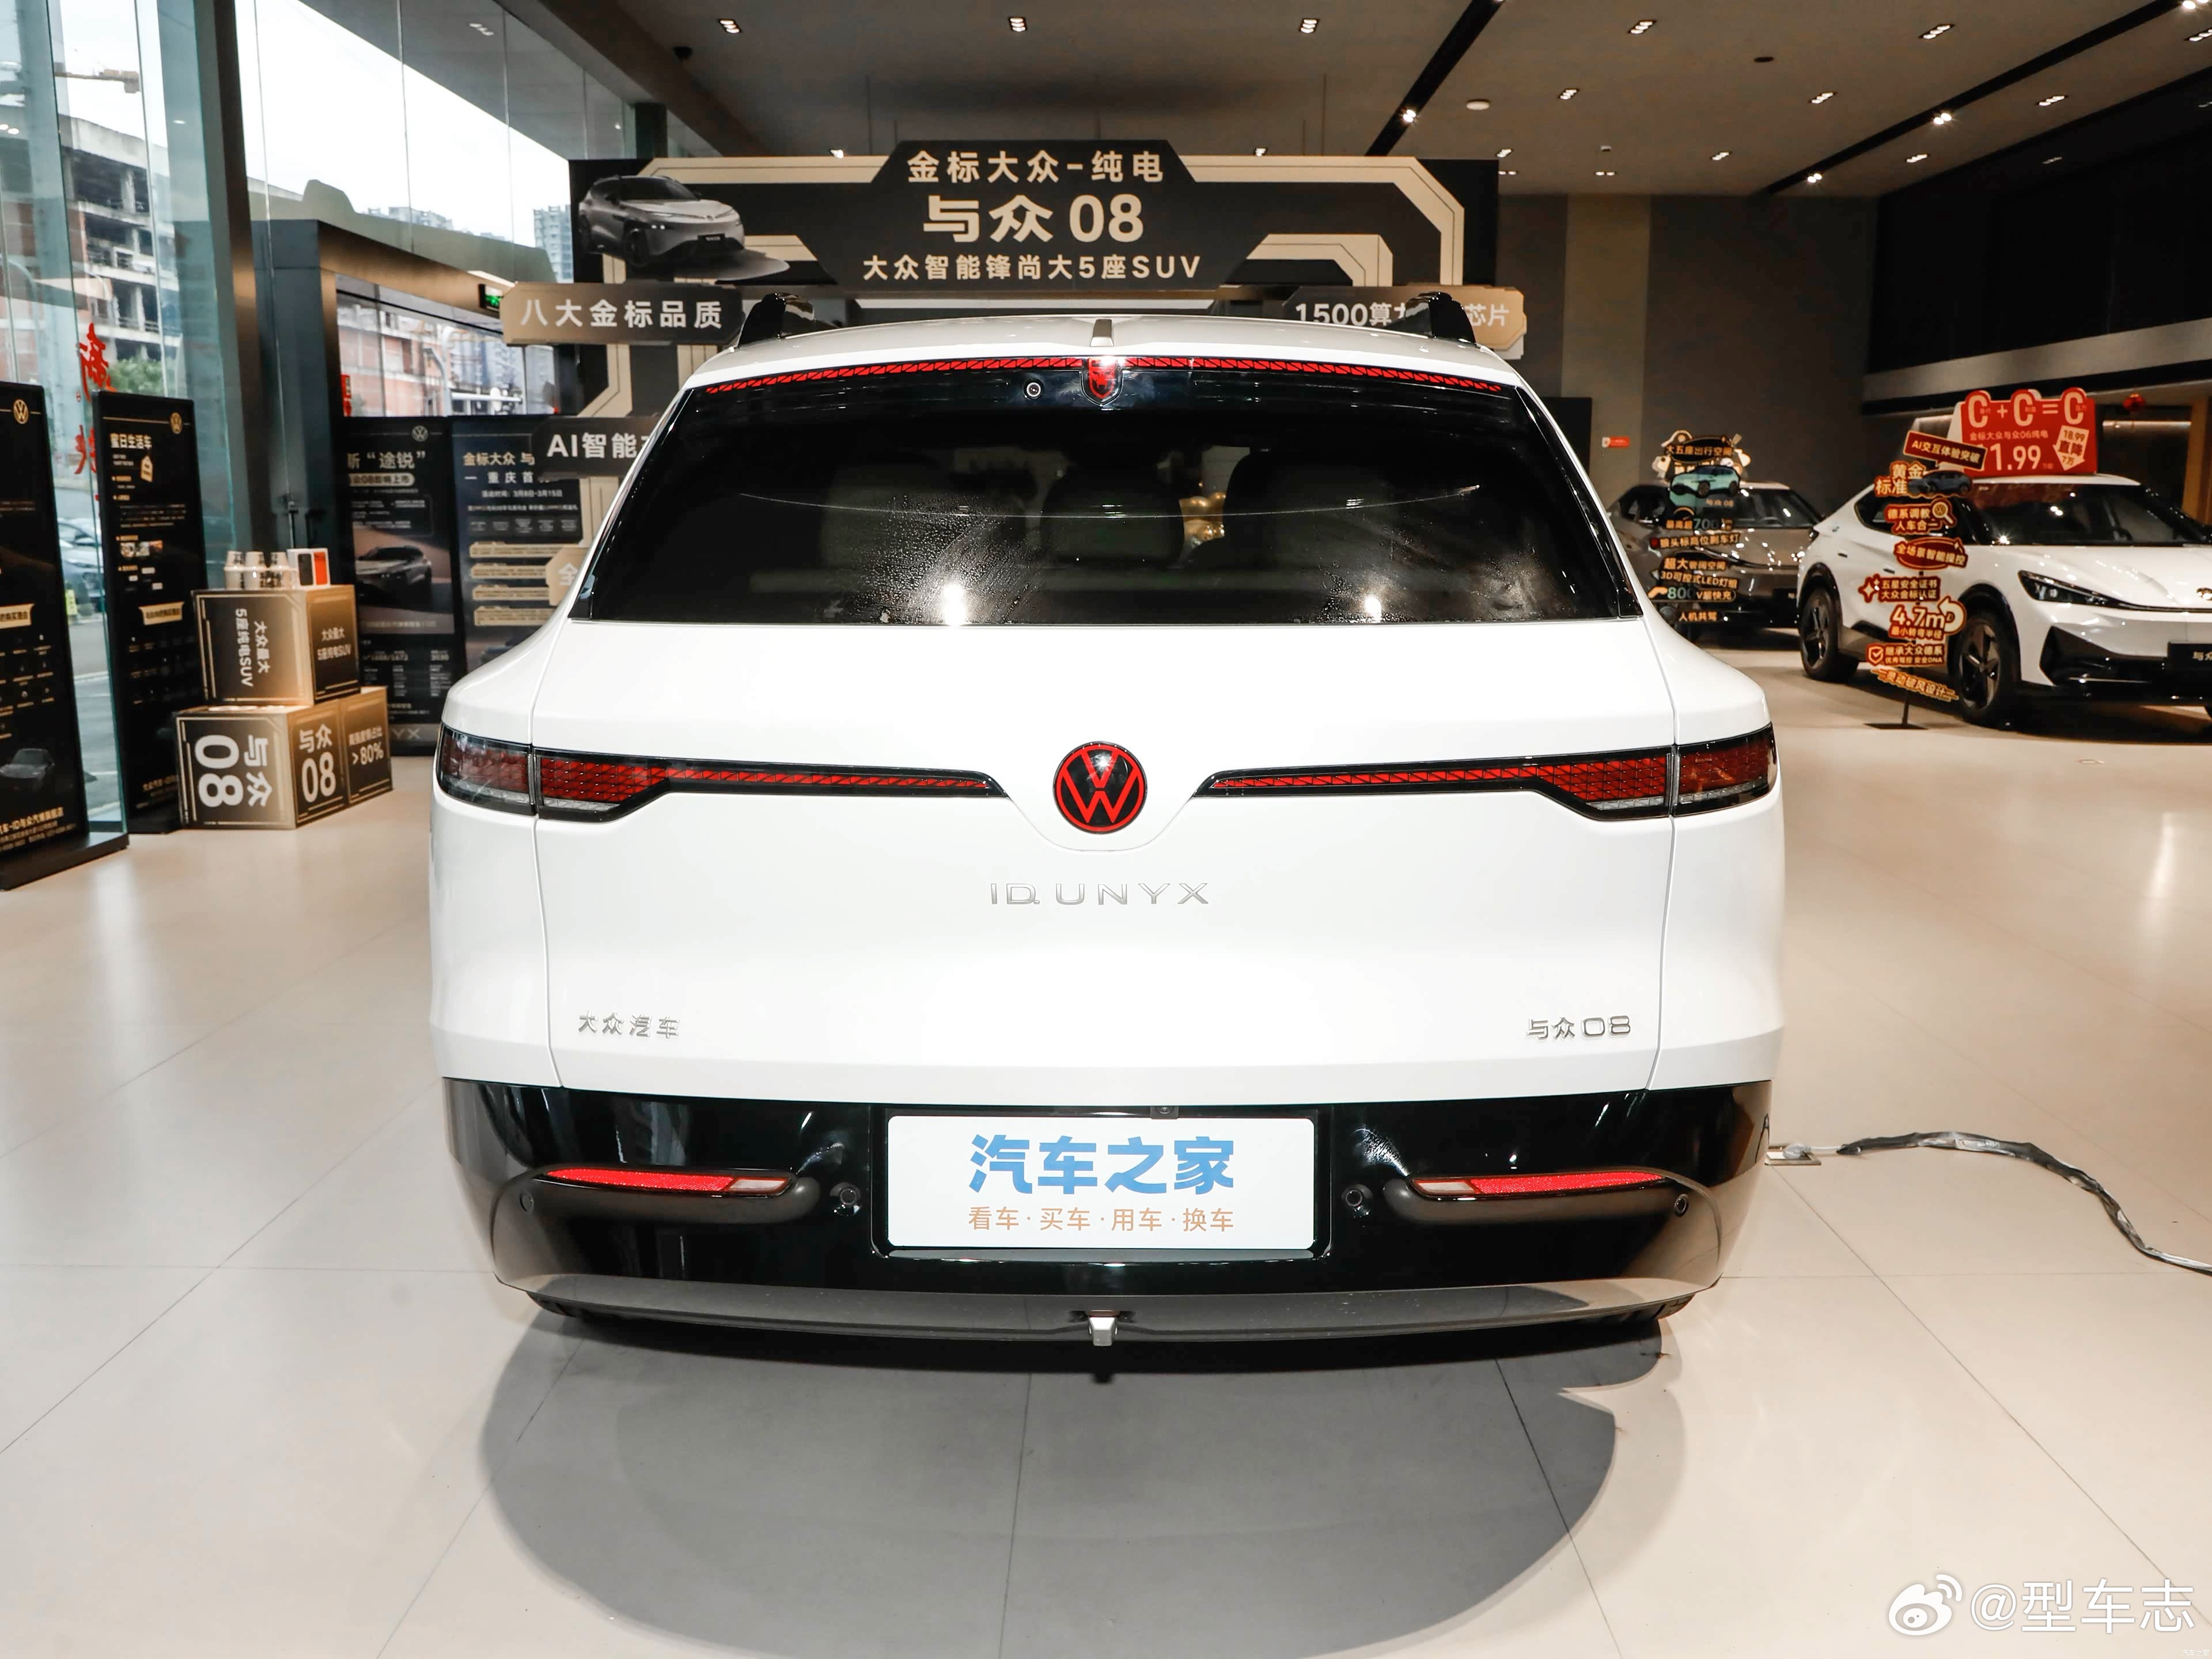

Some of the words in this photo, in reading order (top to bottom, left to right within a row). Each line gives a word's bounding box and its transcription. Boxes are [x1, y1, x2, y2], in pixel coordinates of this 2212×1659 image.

[907, 150, 1163, 183] 金标大众-纯电
[863, 255, 1200, 281] 大众智能锋尚大5座SUV
[521, 299, 722, 328] 八大金标品质
[1892, 464, 1923, 479] 黄金
[1876, 479, 1908, 495] 标准
[1896, 520, 1938, 531] 人车合一
[1892, 607, 1945, 629] 4.7m
[194, 734, 244, 808] 08
[301, 751, 336, 804] 08
[578, 1010, 680, 1039] 大众汽车
[968, 1133, 1234, 1195] 汽车之家
